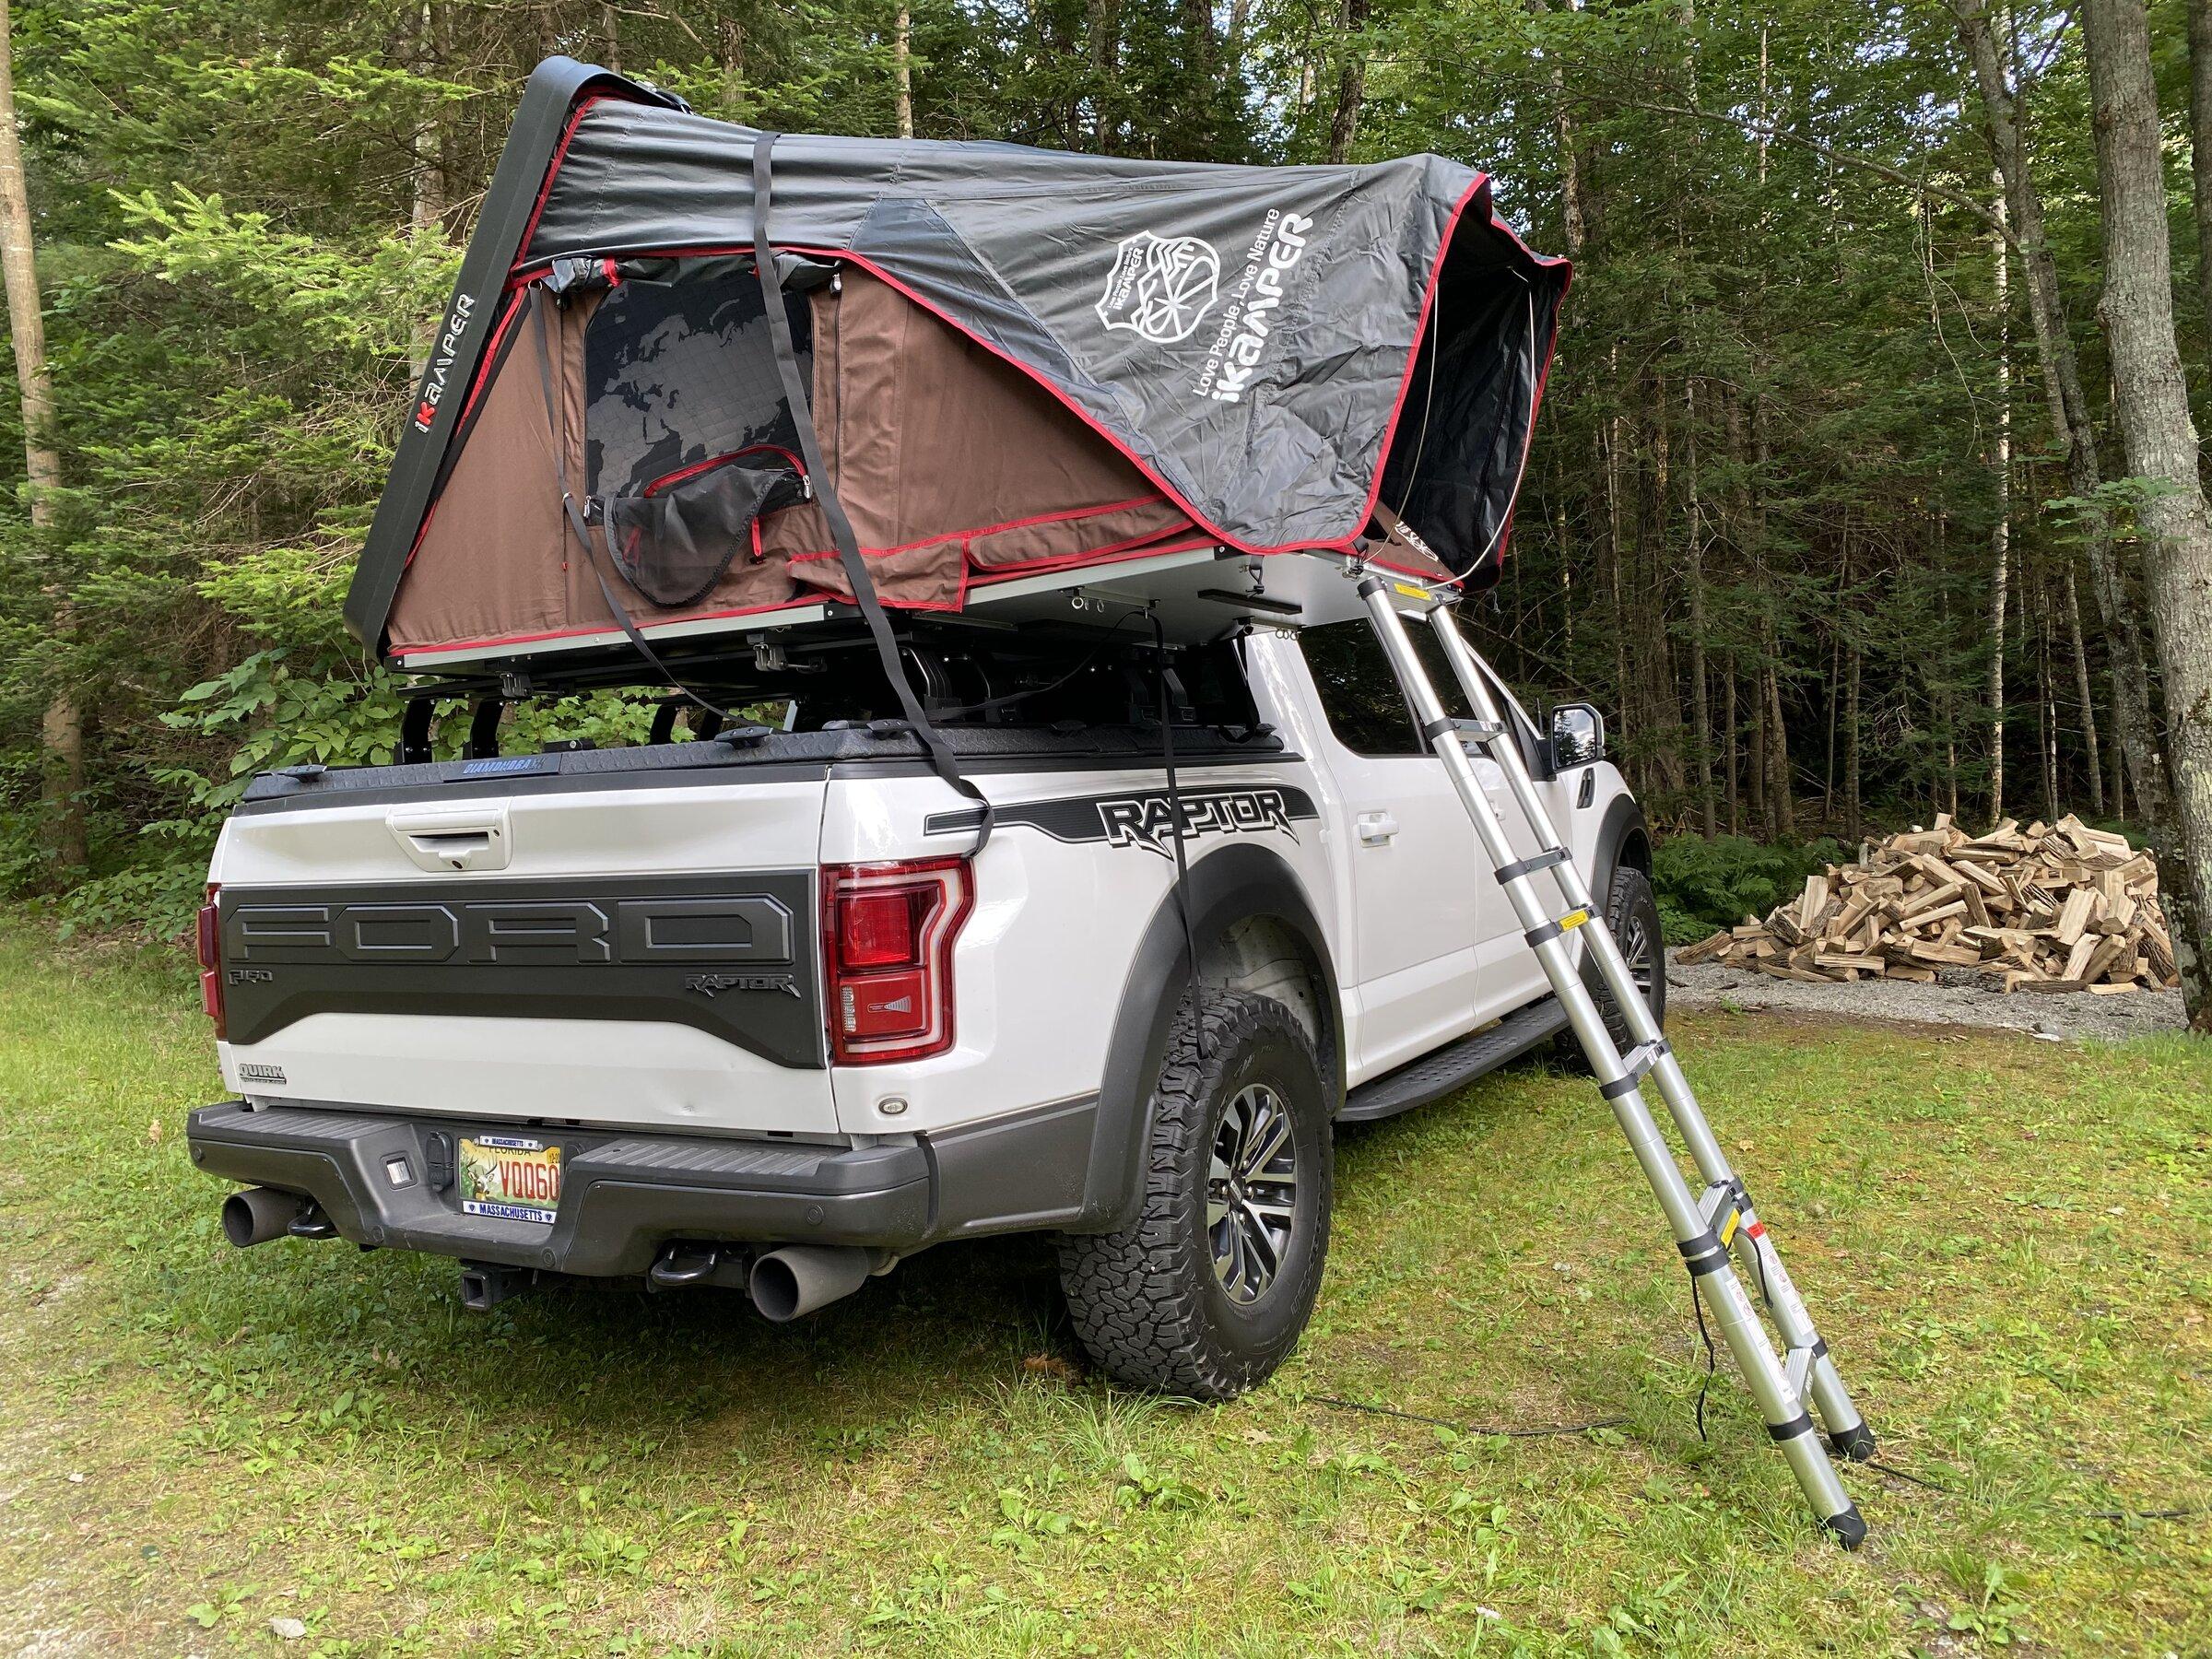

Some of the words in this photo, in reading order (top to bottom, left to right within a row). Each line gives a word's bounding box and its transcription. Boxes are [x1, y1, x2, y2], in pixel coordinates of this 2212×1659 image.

[1193, 359, 1218, 396] Love
[1231, 265, 1258, 300] Love
[1253, 207, 1280, 263] Nature
[1097, 790, 1300, 862] RAPTOR
[227, 894, 794, 964] FORD
[686, 974, 802, 998] RAPTOR
[239, 1063, 285, 1078] QUIRK
[479, 1204, 543, 1221] MASSACHUSETTS
